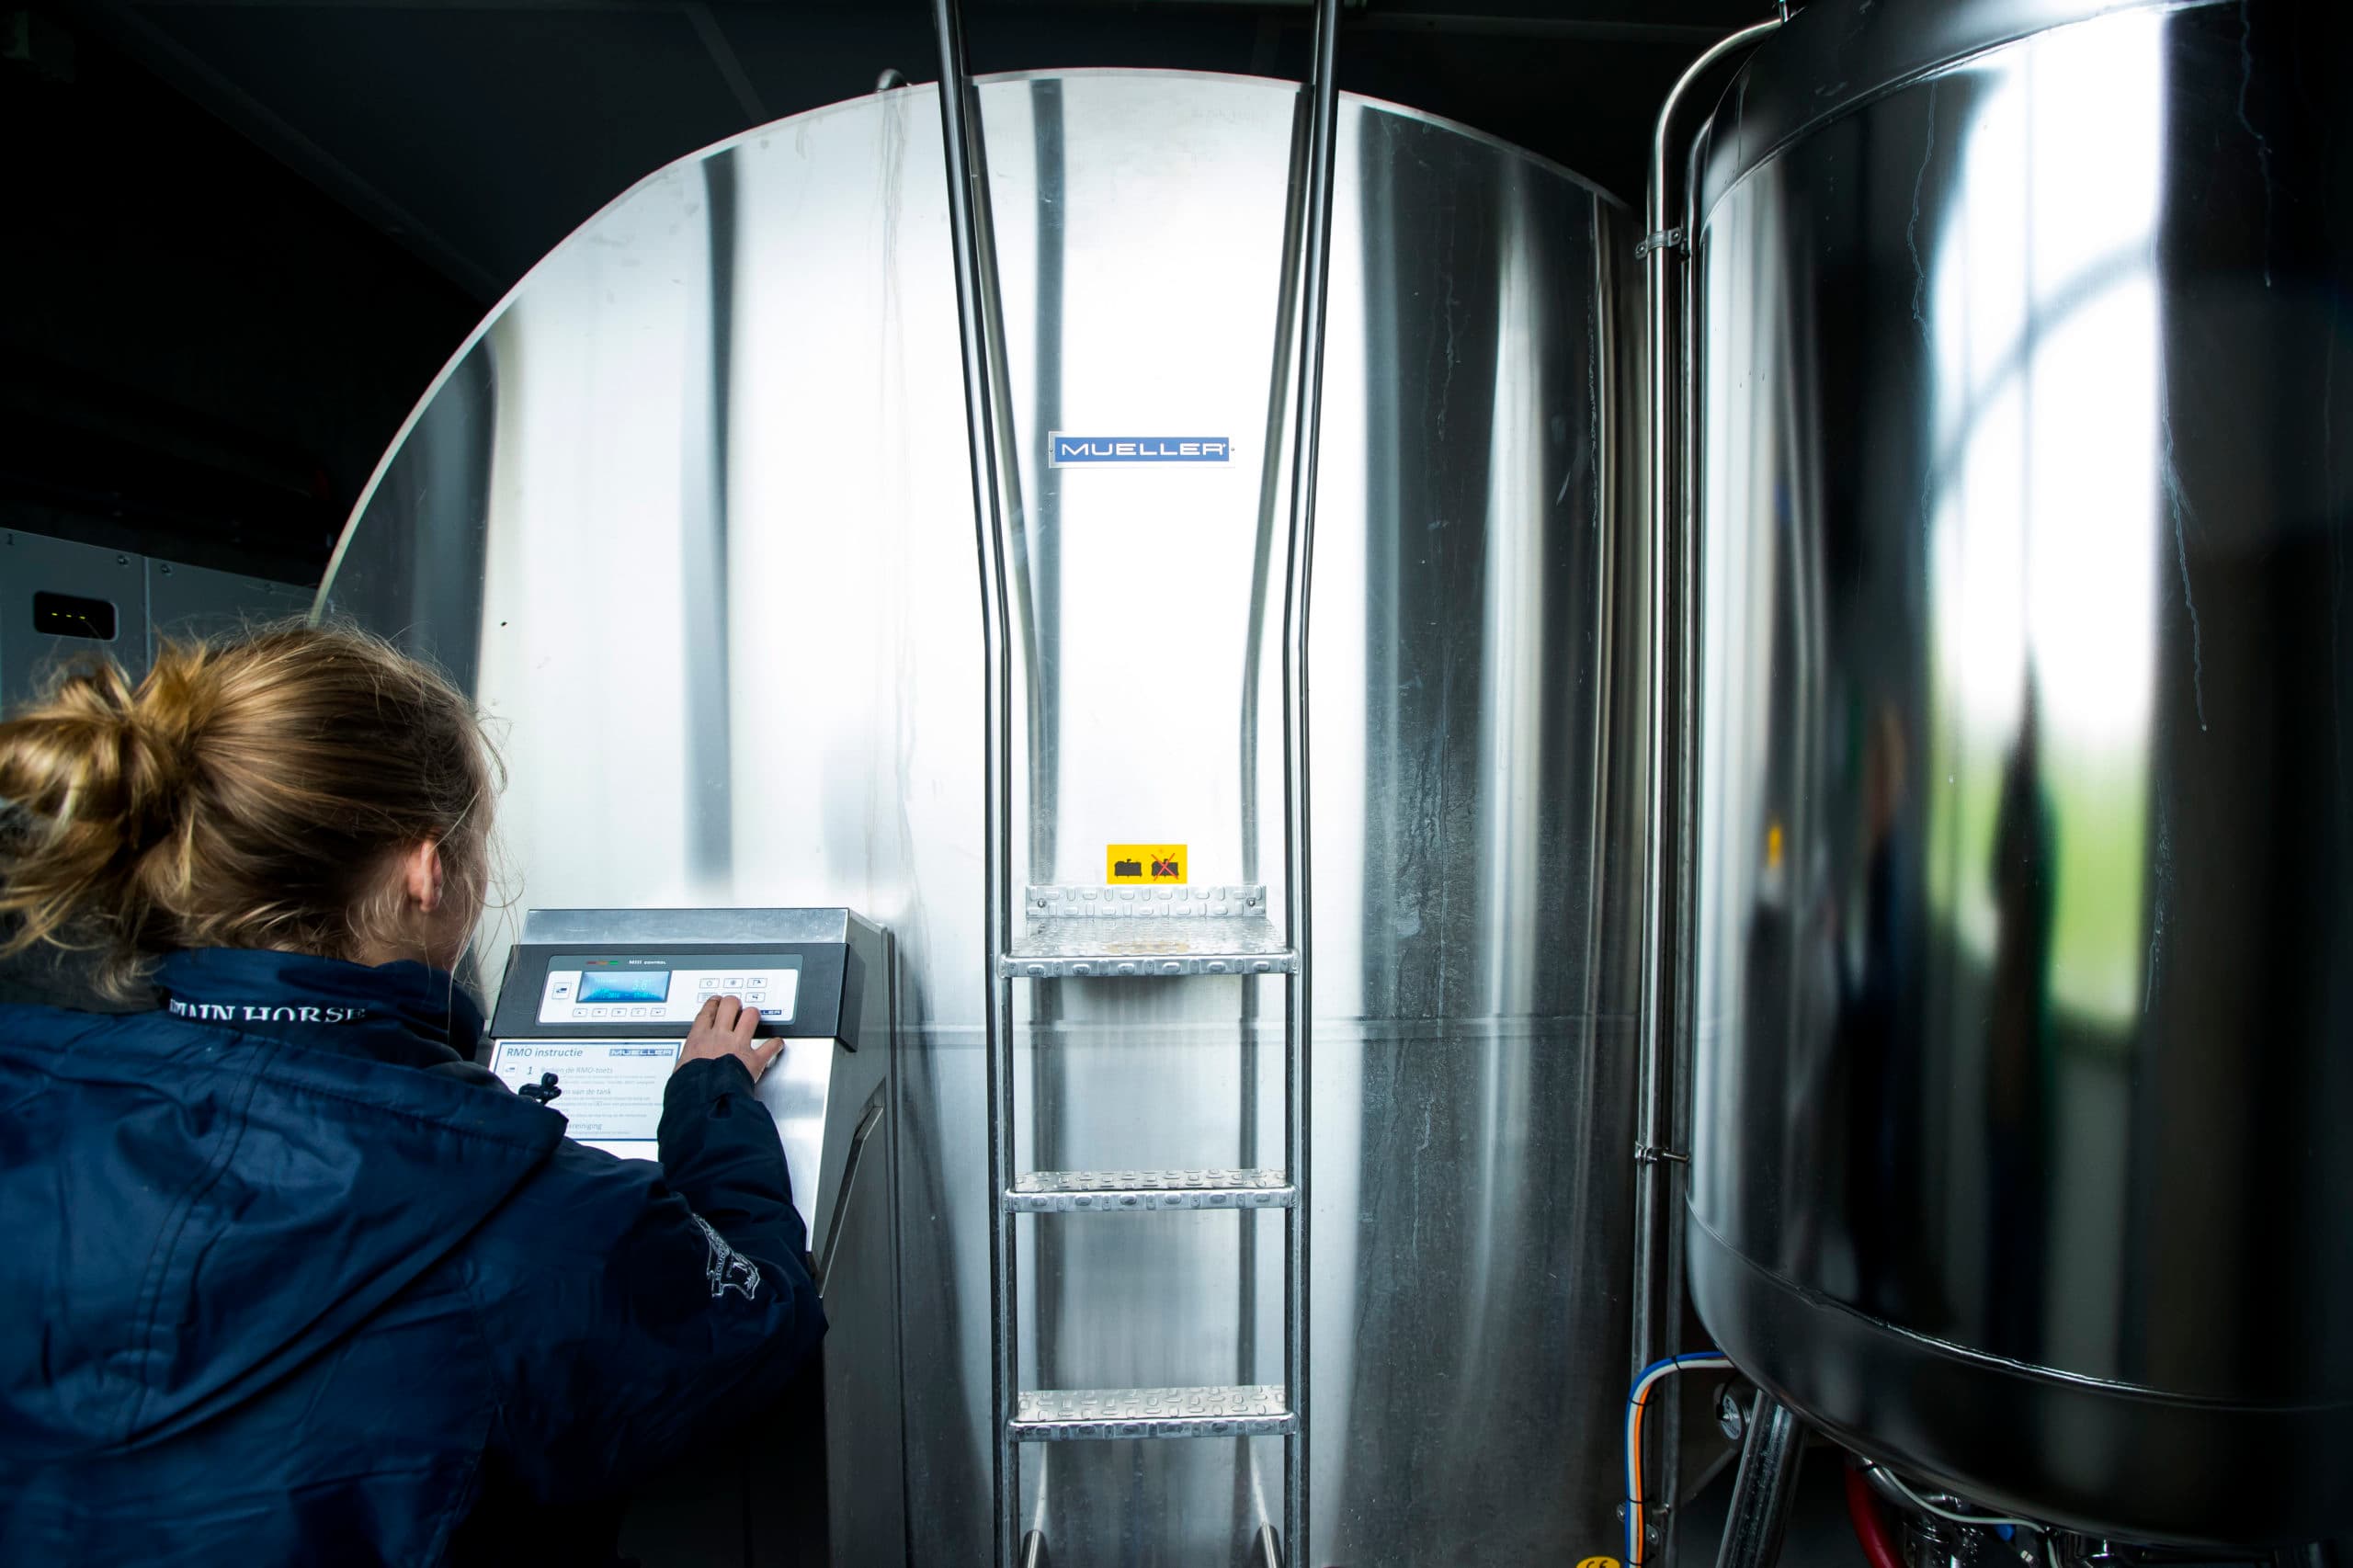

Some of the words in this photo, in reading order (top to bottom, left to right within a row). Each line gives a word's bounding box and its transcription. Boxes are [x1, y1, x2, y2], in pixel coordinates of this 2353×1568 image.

[1062, 443, 1225, 456] MUELLER
[506, 1048, 532, 1057] RMO
[534, 1047, 584, 1057] instructie
[527, 1066, 533, 1075] 1
